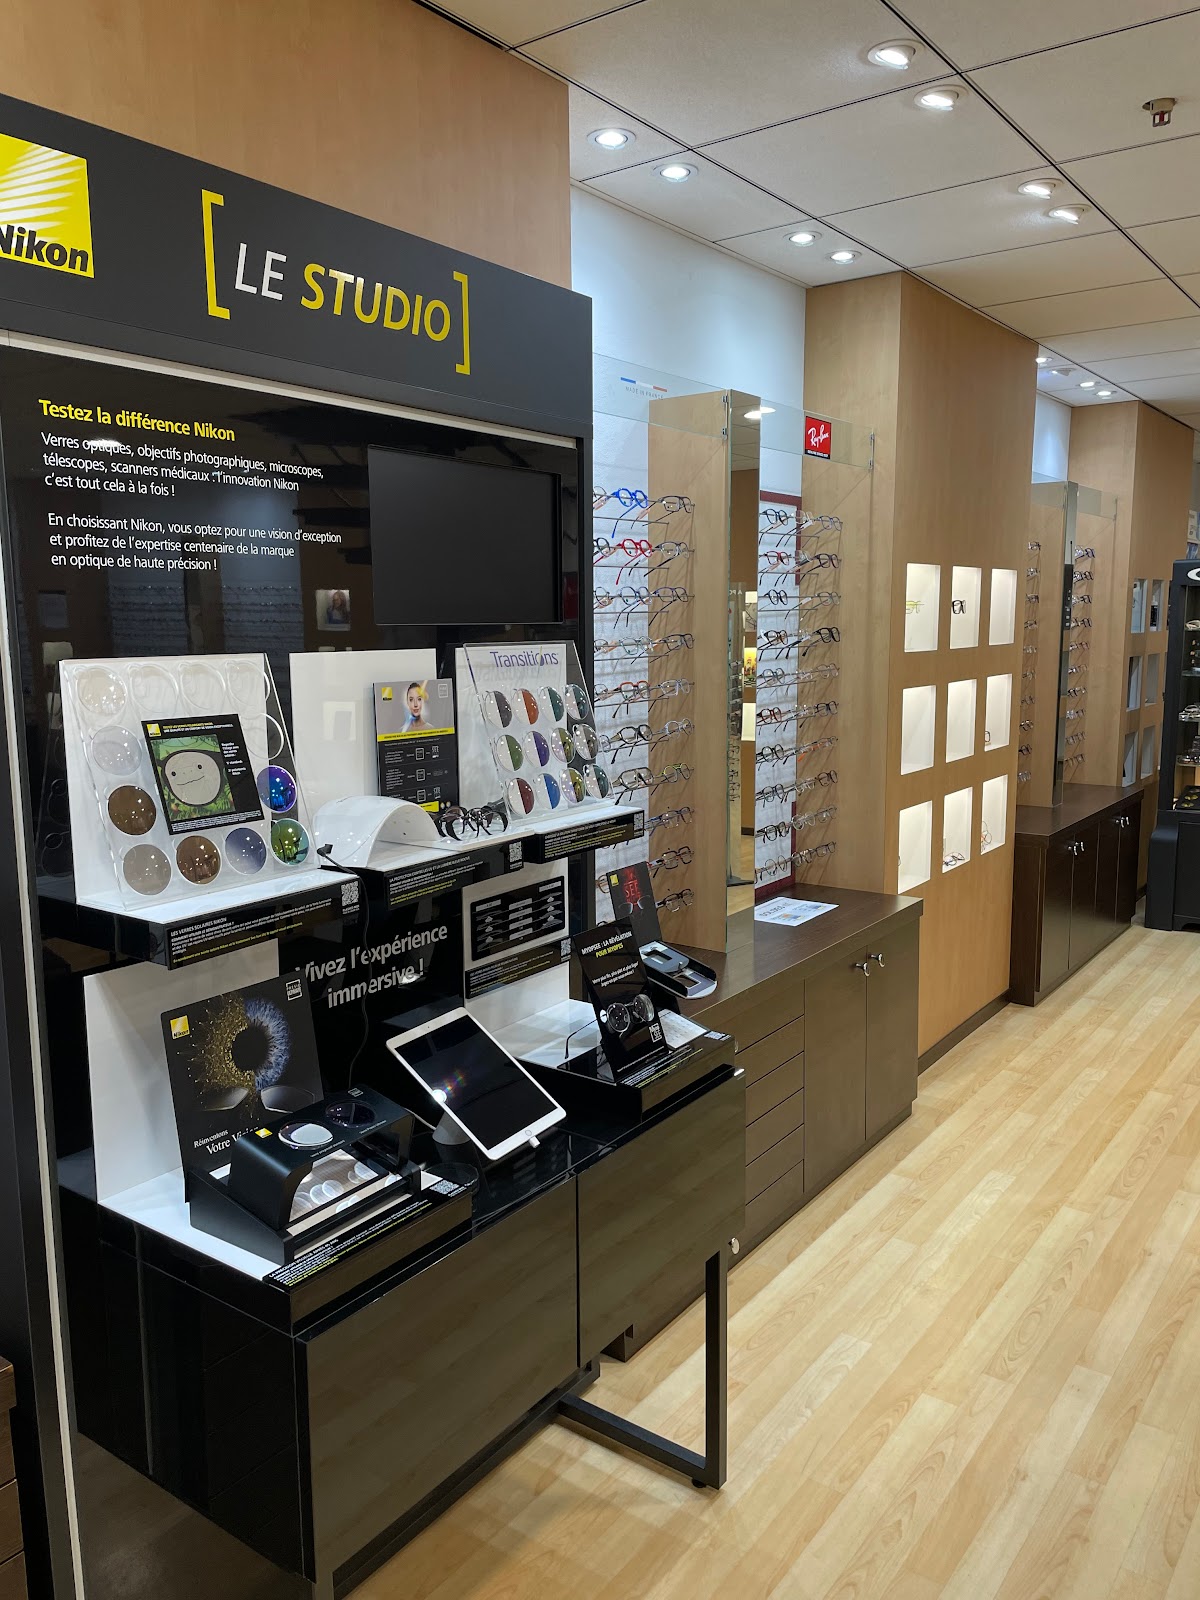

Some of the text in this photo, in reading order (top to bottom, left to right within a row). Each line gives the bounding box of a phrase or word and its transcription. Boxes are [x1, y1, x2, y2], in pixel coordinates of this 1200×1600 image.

[0, 224, 89, 272] Nikon
[234, 243, 287, 300] LE
[301, 263, 450, 341] STUDIO
[39, 399, 235, 441] Testez la différence Nikon
[41, 431, 324, 479] Verres optiques, objectifs photographiques, microscopes,
[43, 452, 108, 473] télescopes,
[110, 462, 158, 477] scanners
[160, 466, 210, 482] médicaux
[217, 470, 271, 489] l'innovation
[273, 478, 299, 491] Nikon
[44, 472, 73, 488] c'est
[76, 477, 101, 490] tout
[103, 478, 126, 492] cela
[128, 480, 135, 493] à
[138, 481, 147, 494] la
[150, 482, 169, 496] fois
[48, 512, 342, 544] En choisissant Nikon, vous optez pour une vision d'exception
[49, 533, 294, 558] et profitez de l'expertise centenaire de la marque
[51, 554, 66, 566] en
[69, 553, 114, 569] optique
[116, 554, 131, 568] de
[133, 555, 165, 569] haute
[167, 557, 211, 571] précision
[490, 650, 559, 669] Transitions
[351, 925, 448, 969] l'expérience
[328, 965, 415, 1008] immersive
[193, 1128, 229, 1149] Réinventons
[206, 1138, 231, 1155] Votre
